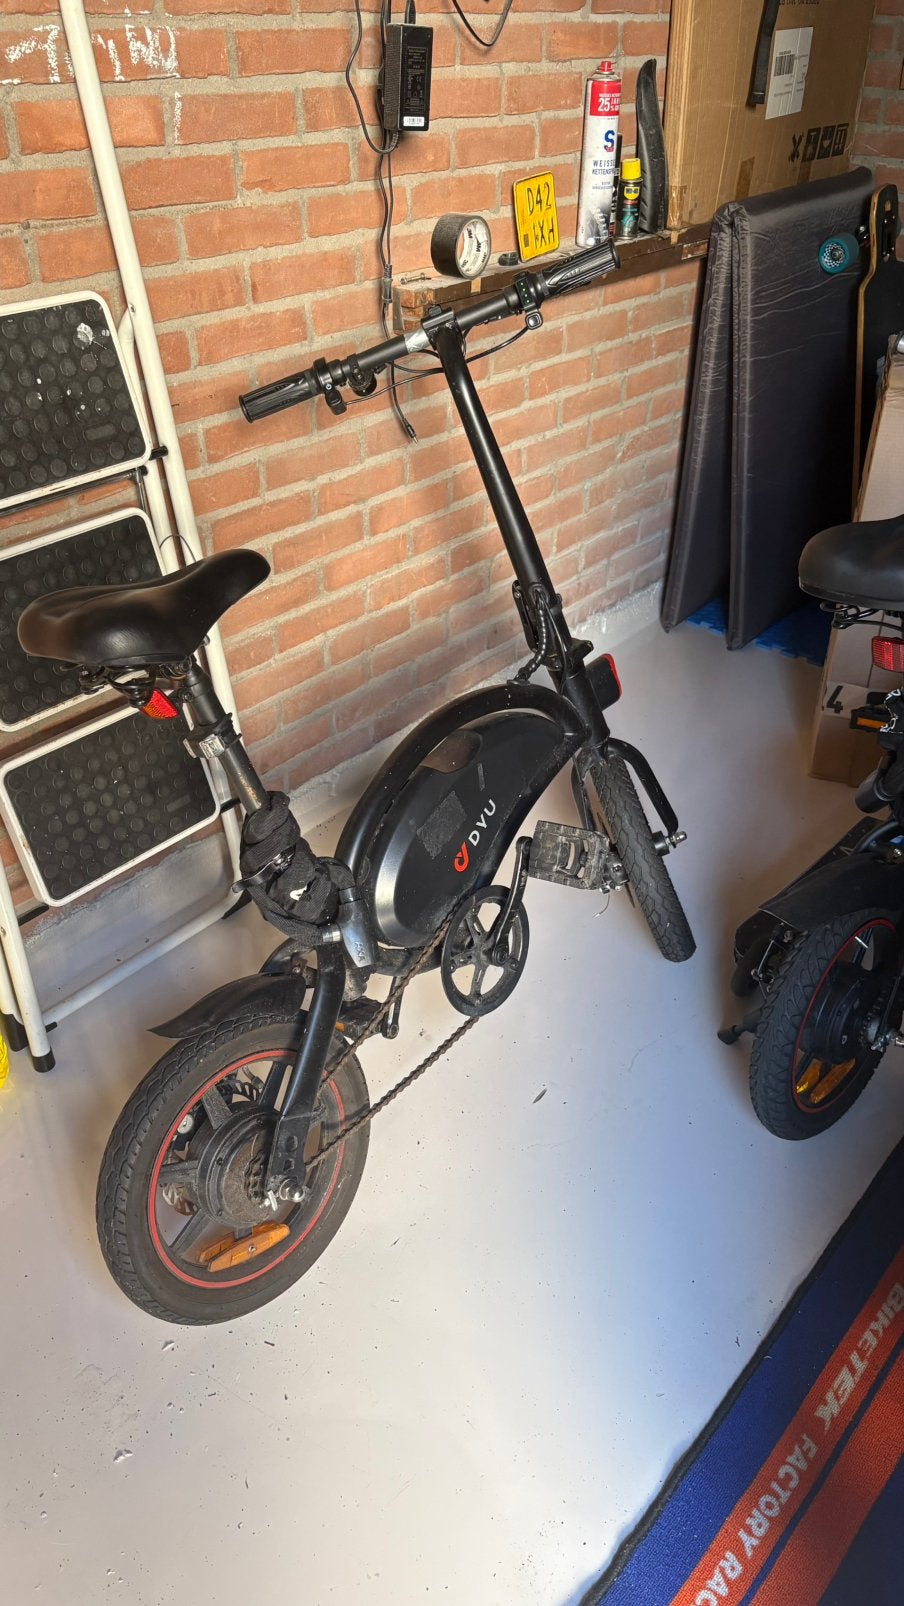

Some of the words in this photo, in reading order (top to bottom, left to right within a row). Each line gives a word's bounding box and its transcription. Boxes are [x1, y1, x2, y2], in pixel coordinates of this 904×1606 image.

[597, 97, 610, 112] 25
[468, 799, 496, 847] DYU
[737, 1432, 818, 1558] FACTORY
